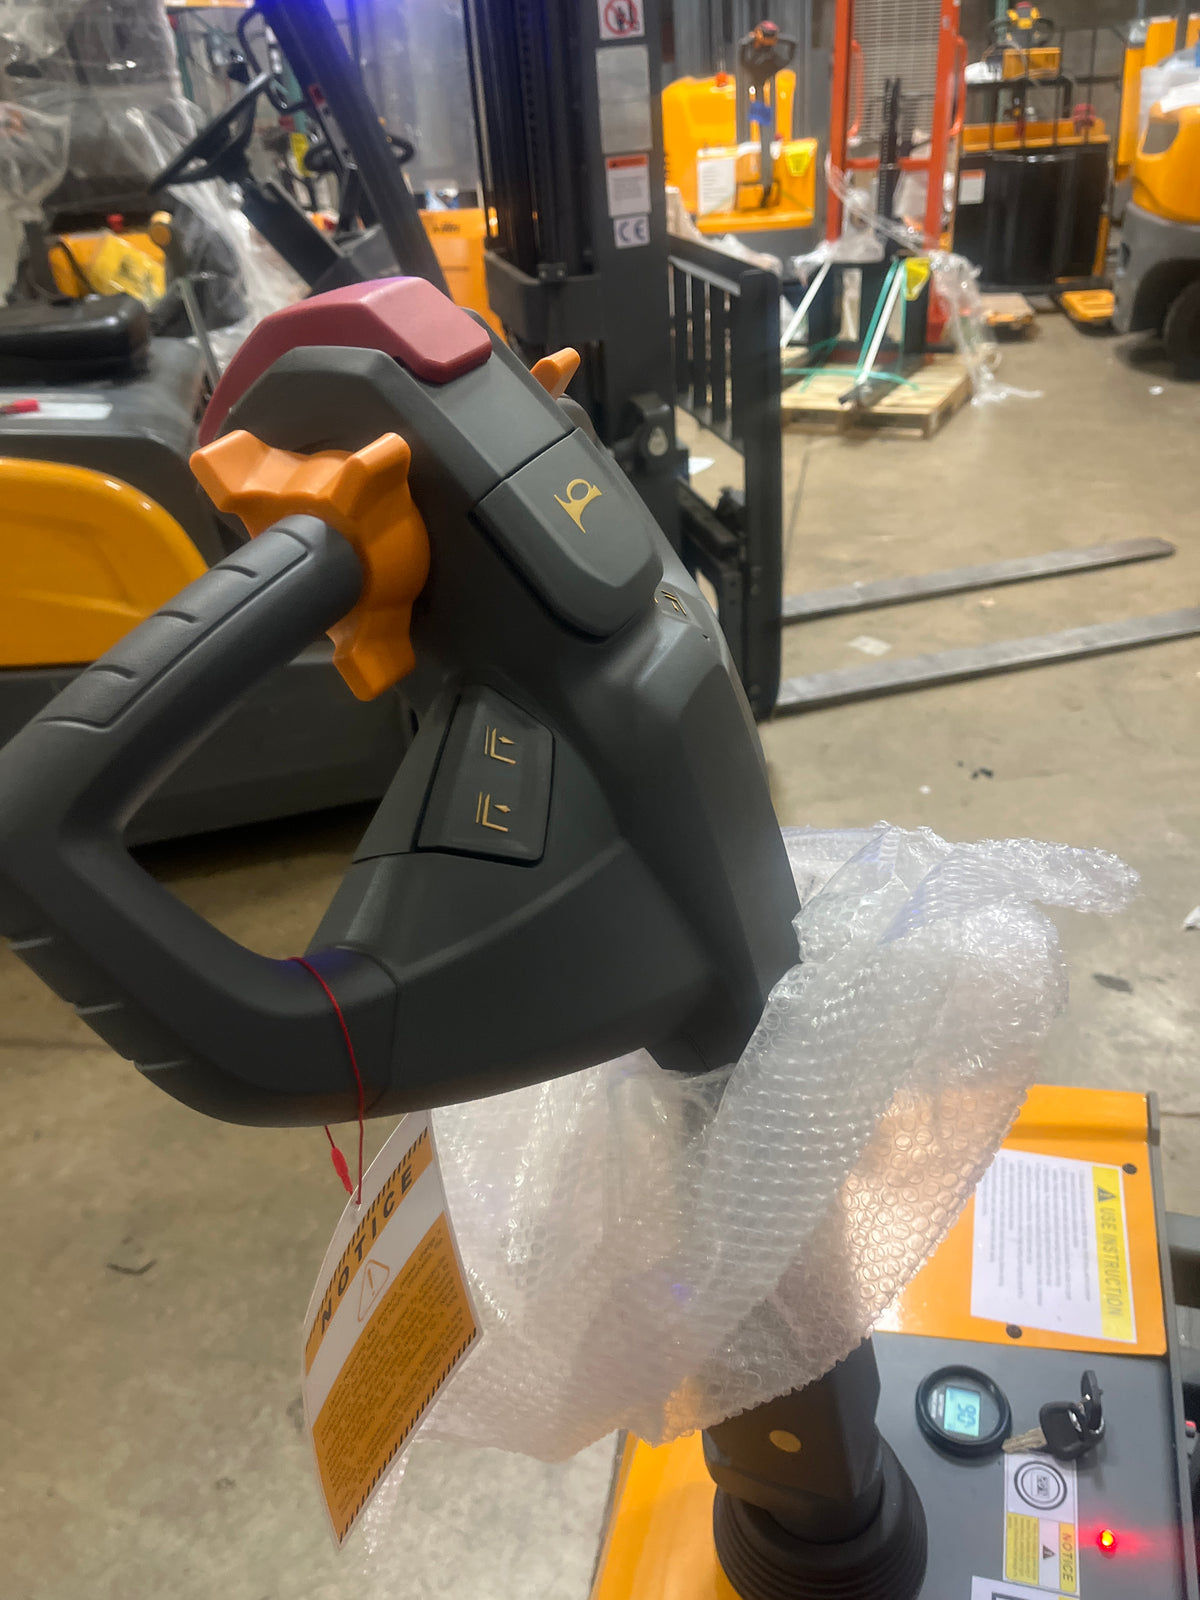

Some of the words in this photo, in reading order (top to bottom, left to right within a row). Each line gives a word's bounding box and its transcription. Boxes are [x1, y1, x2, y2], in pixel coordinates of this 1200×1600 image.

[618, 219, 645, 243] CE
[1100, 1207, 1117, 1231] USE
[321, 1165, 413, 1335] NOTICE
[1103, 1233, 1123, 1317] INSTRUCTION
[1062, 1533, 1073, 1582] NOTICE
